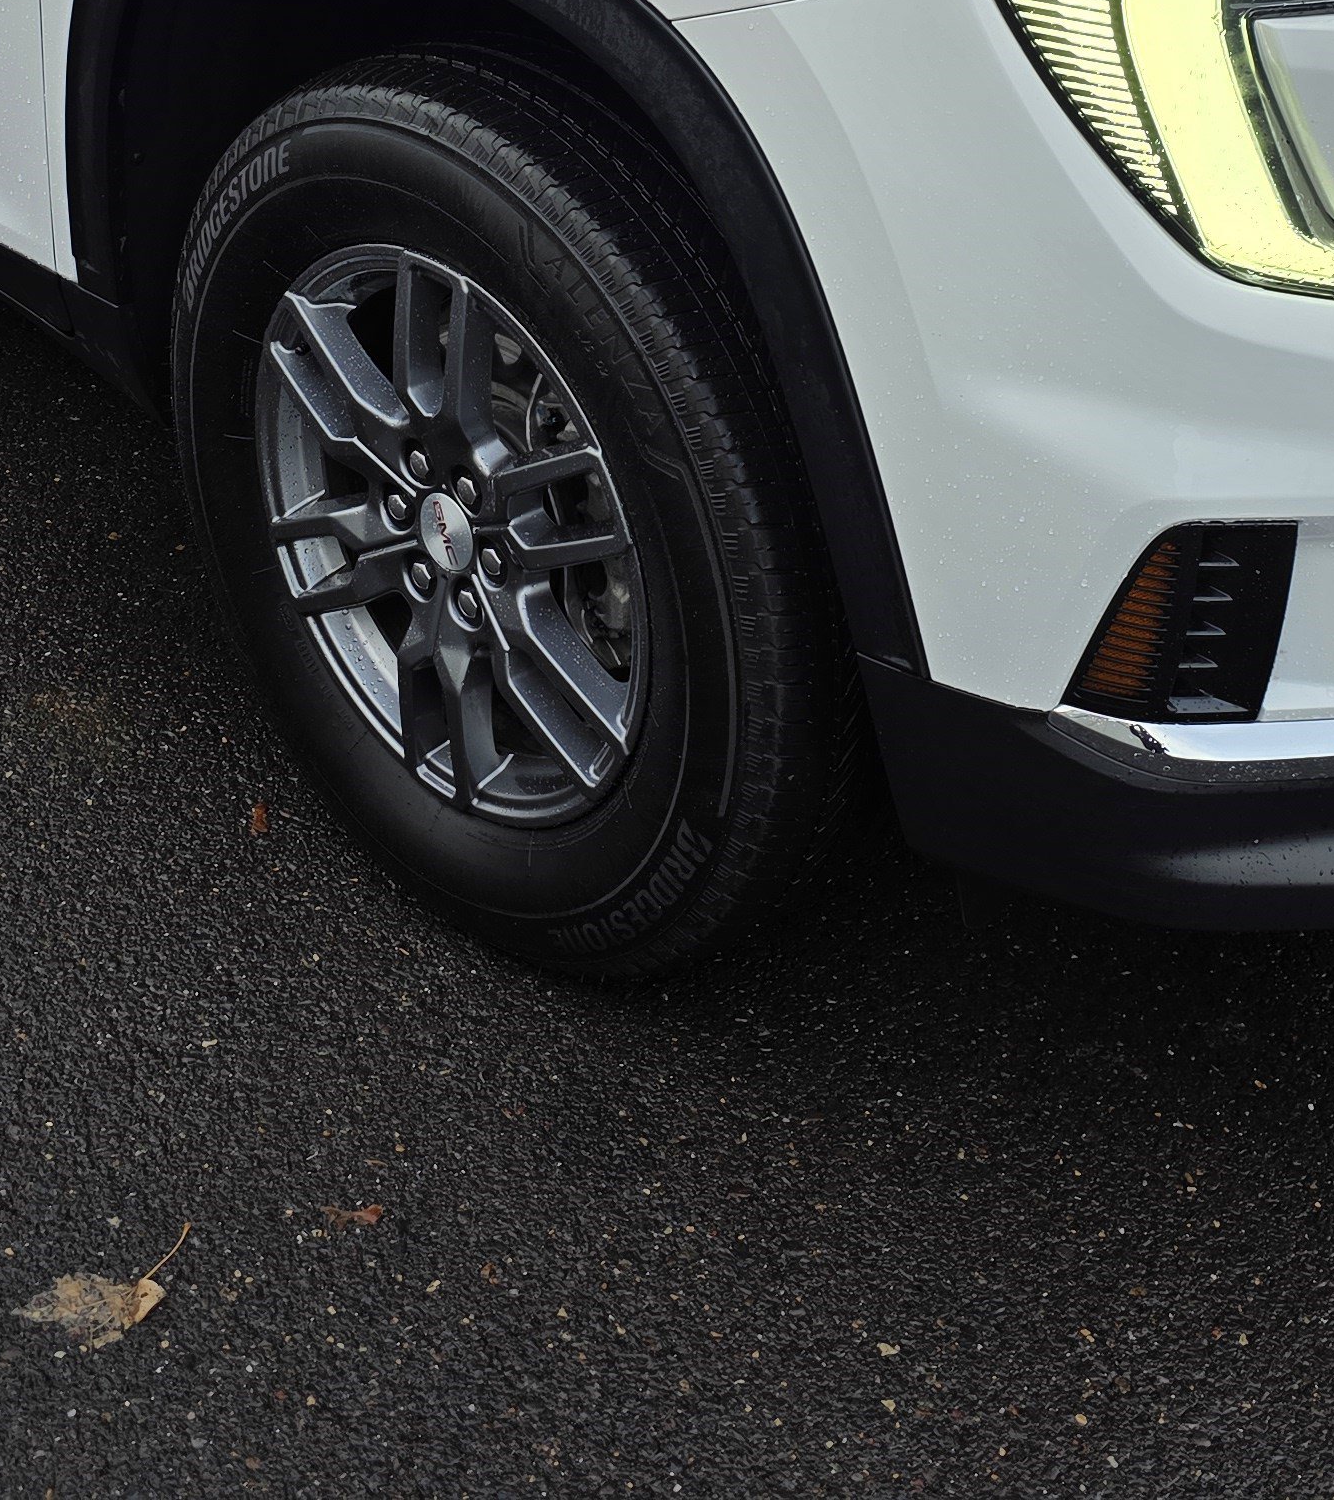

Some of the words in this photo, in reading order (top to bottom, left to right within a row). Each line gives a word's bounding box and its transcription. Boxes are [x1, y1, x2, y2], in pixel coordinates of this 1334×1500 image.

[182, 139, 291, 313] BRIDGESTONE
[432, 500, 459, 566] GMC
[547, 818, 714, 953] BRIDGESTONE
